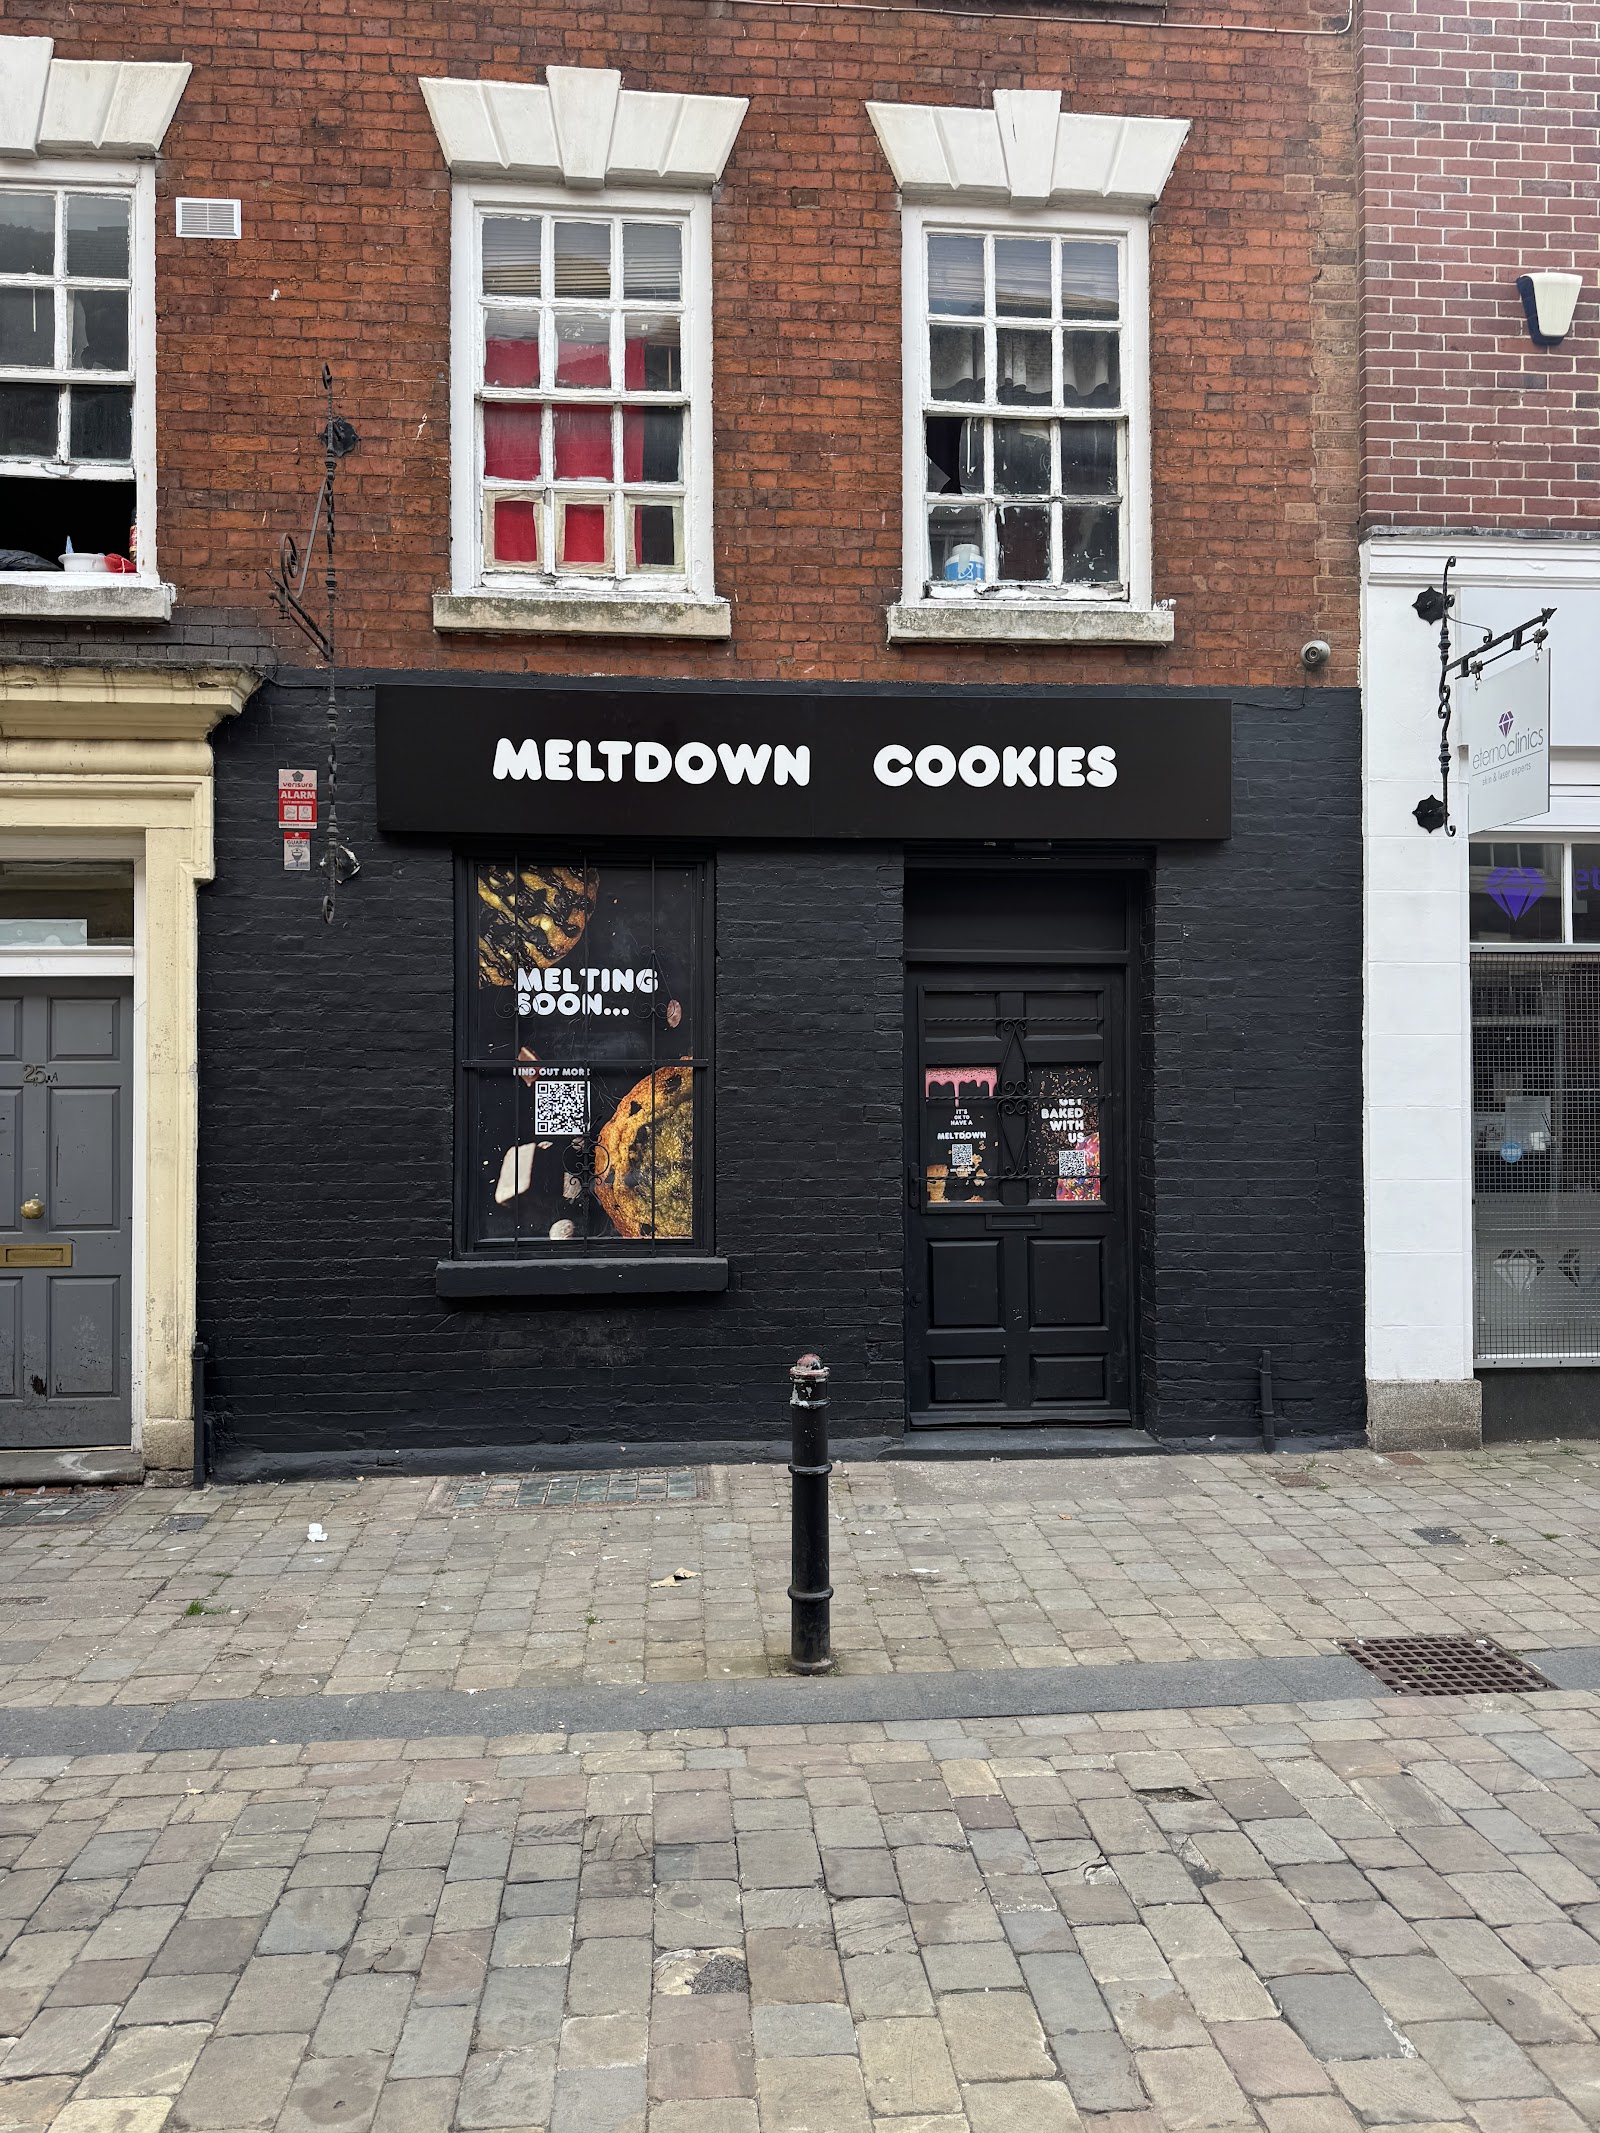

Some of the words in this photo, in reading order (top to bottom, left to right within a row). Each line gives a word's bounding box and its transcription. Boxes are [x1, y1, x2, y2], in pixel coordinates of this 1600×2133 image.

[1472, 727, 1544, 770] eternoclinics
[492, 737, 811, 786] MELTDOWN
[873, 744, 1118, 788] COOKIES
[280, 790, 317, 799] ALARM
[514, 967, 659, 994] MELTING
[538, 1067, 560, 1077] OUT
[1058, 1098, 1082, 1106] GET
[1041, 1107, 1084, 1119] BAKED
[1049, 1120, 1084, 1131] WITH
[937, 1131, 987, 1140] MELTDOWN
[1067, 1132, 1085, 1143] US
